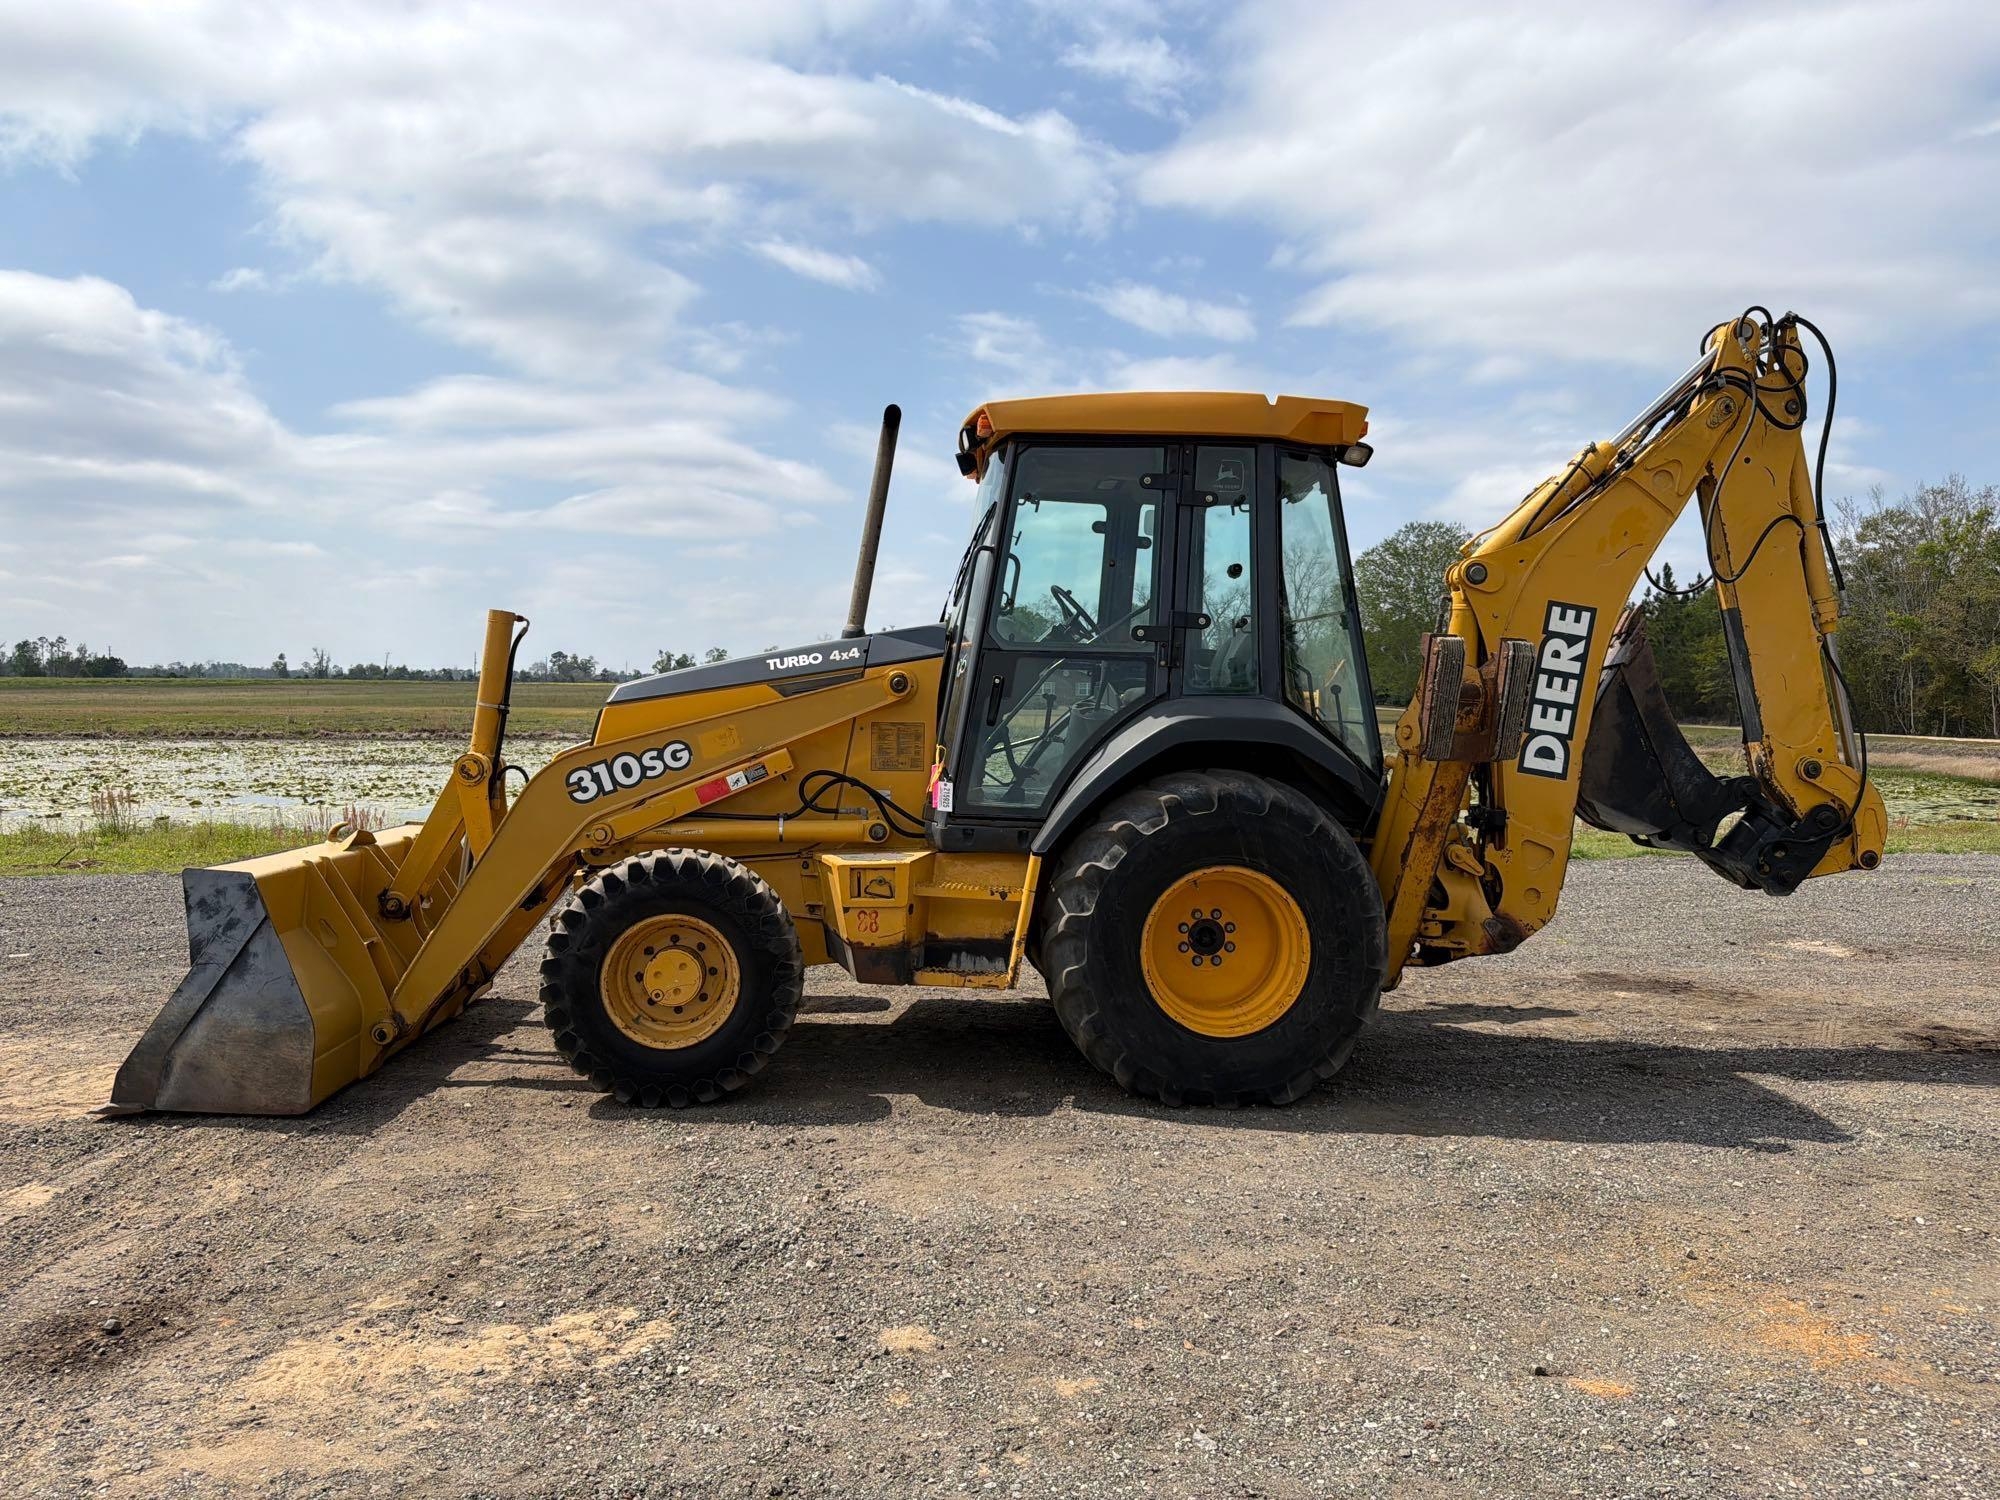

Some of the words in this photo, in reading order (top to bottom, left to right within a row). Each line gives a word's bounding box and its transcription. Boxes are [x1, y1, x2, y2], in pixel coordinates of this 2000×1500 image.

[766, 652, 823, 671] TURBO
[829, 647, 860, 661] 4x4
[1522, 604, 1593, 775] DEERE
[568, 741, 690, 802] 310SG
